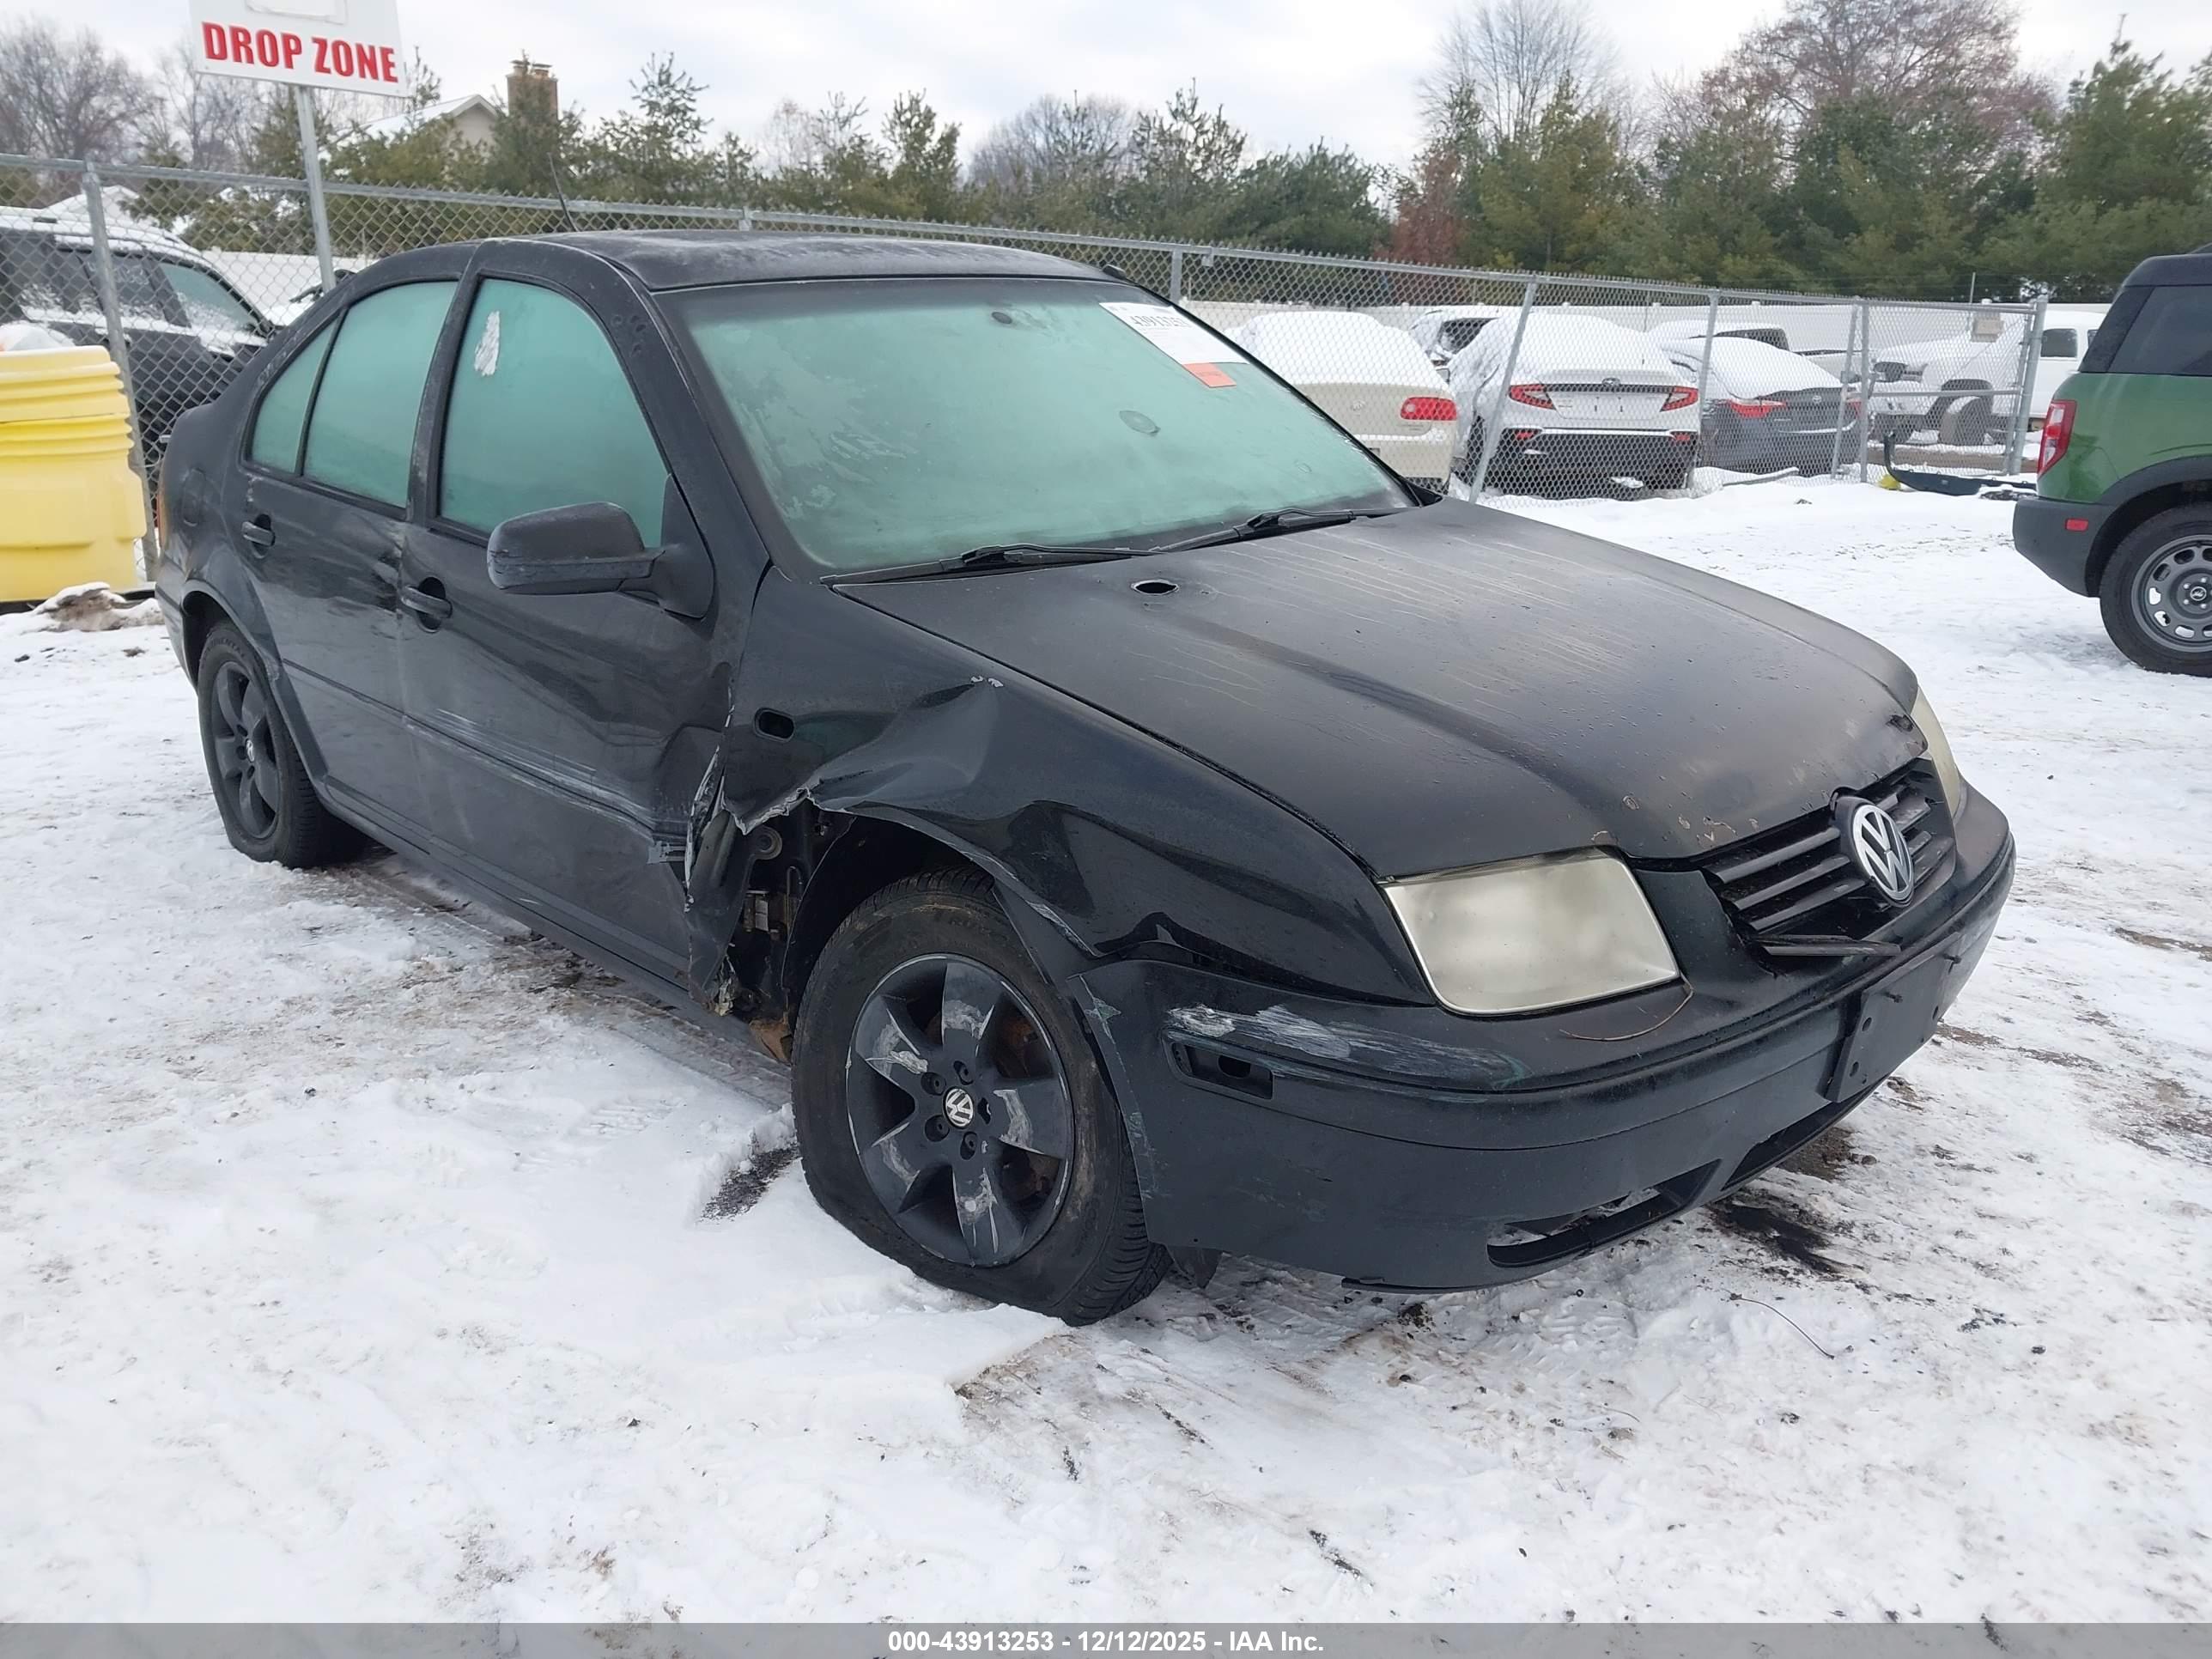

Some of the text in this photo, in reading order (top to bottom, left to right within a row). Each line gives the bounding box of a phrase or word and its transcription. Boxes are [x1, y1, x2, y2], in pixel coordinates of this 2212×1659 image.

[201, 21, 399, 83] DROP ZONE
[1853, 805, 1914, 901] VW
